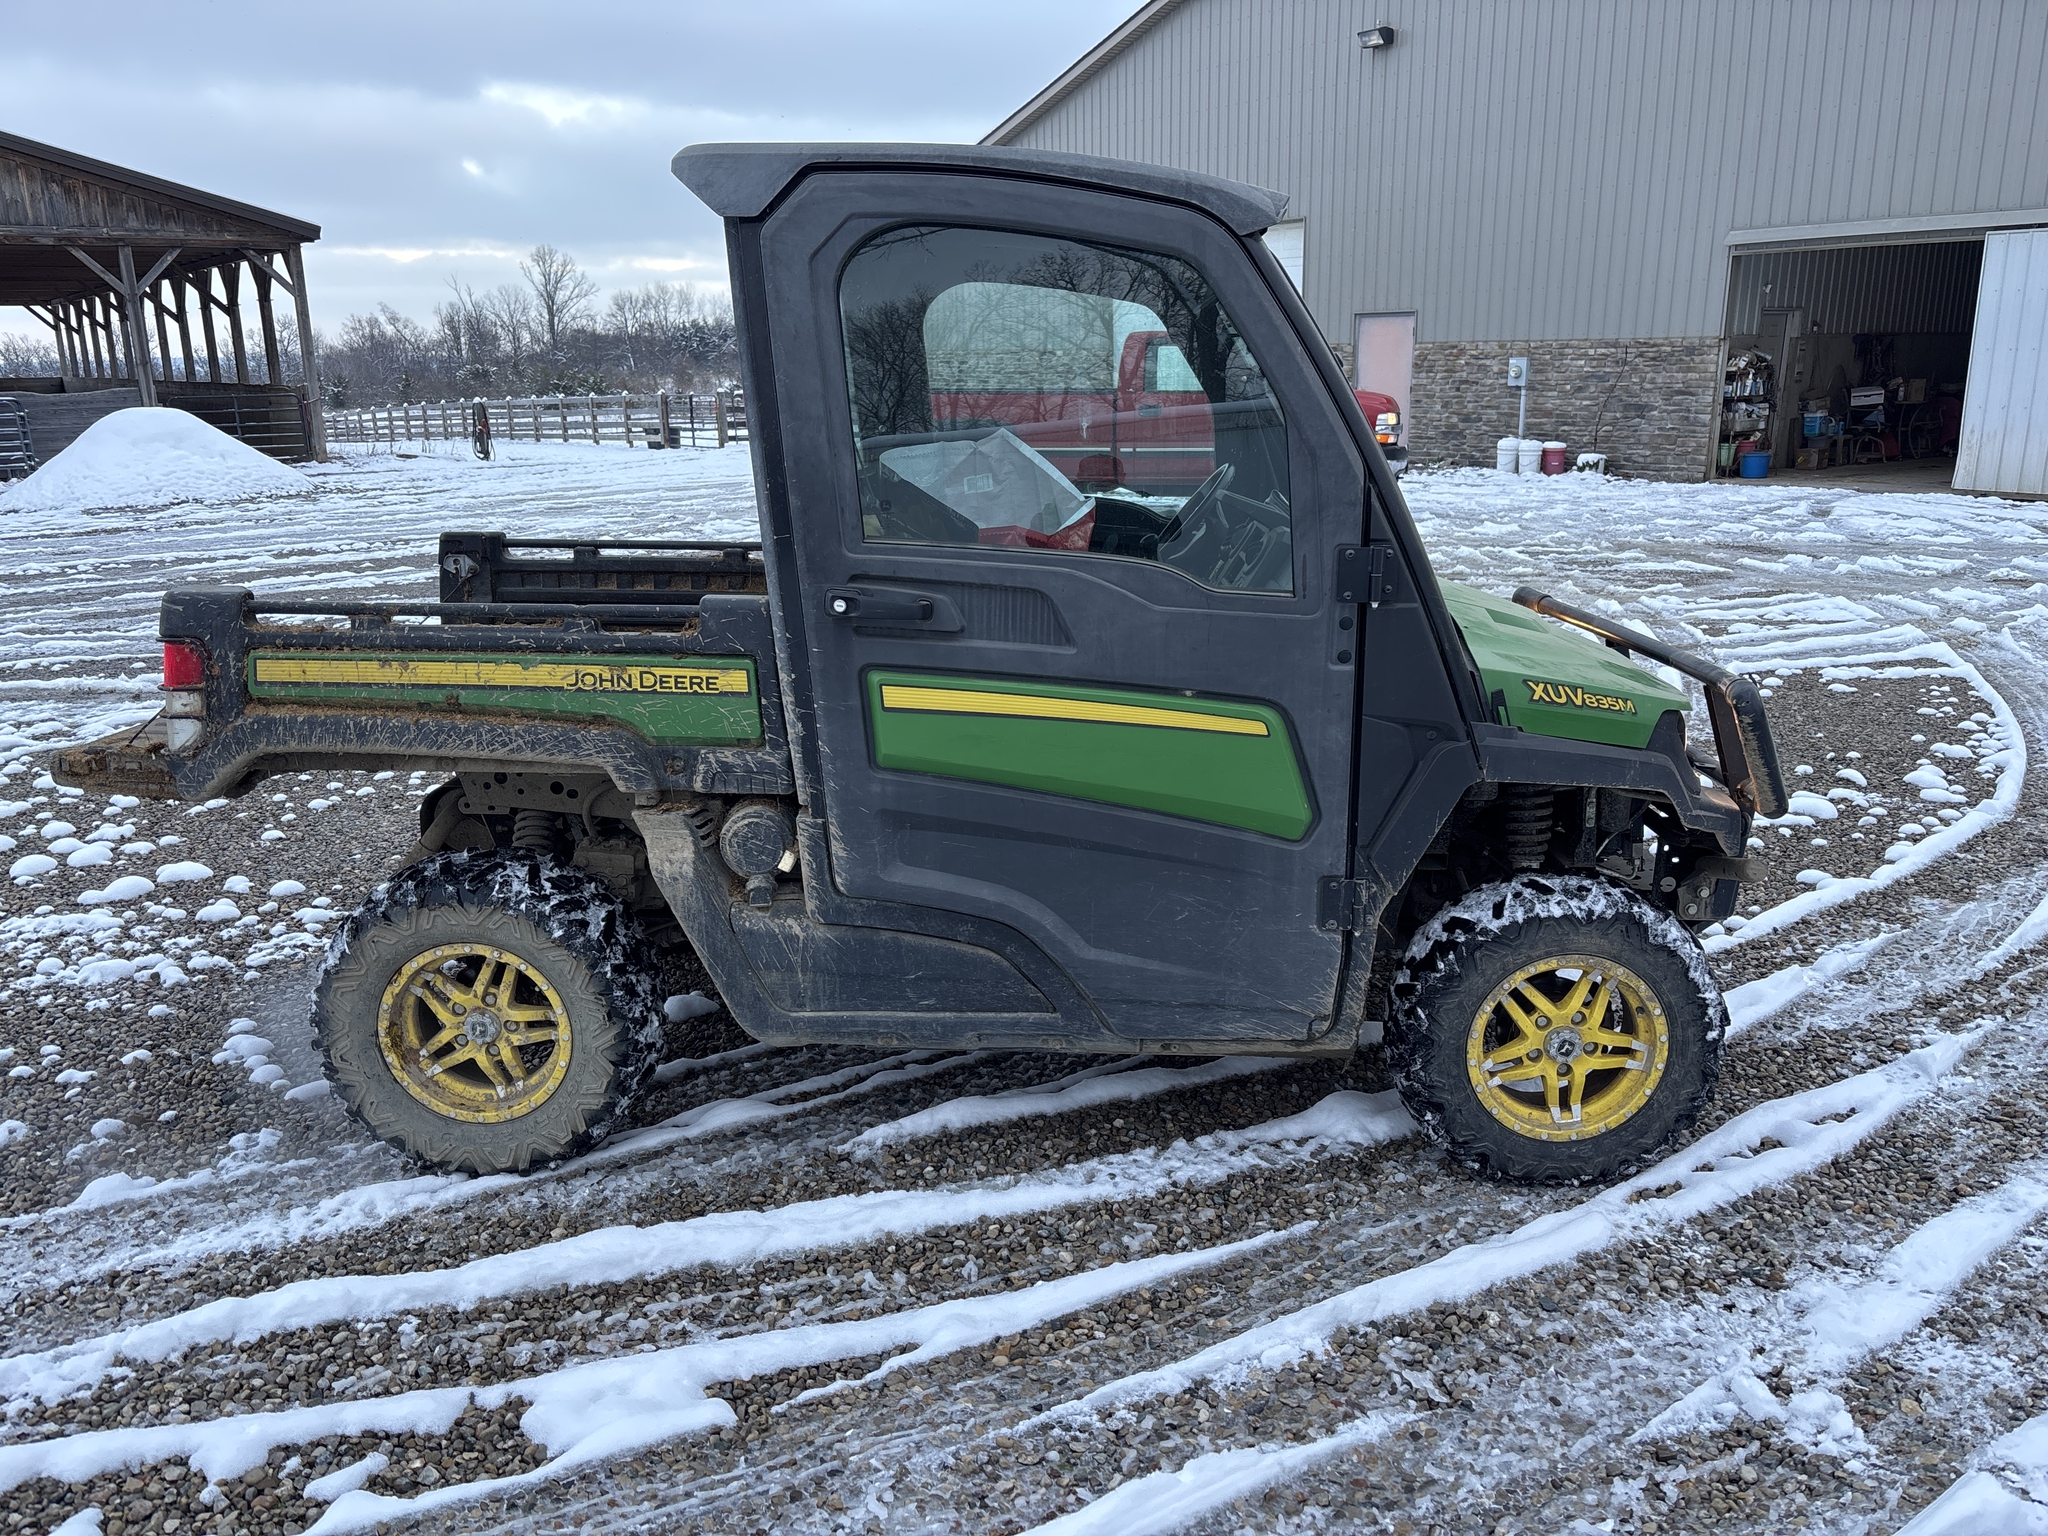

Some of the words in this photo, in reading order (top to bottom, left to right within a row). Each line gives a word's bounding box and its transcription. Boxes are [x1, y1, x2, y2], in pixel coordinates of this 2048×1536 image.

[566, 669, 632, 688] JOHN
[639, 670, 719, 692] DEERE
[1524, 680, 1636, 714] XUV835M
